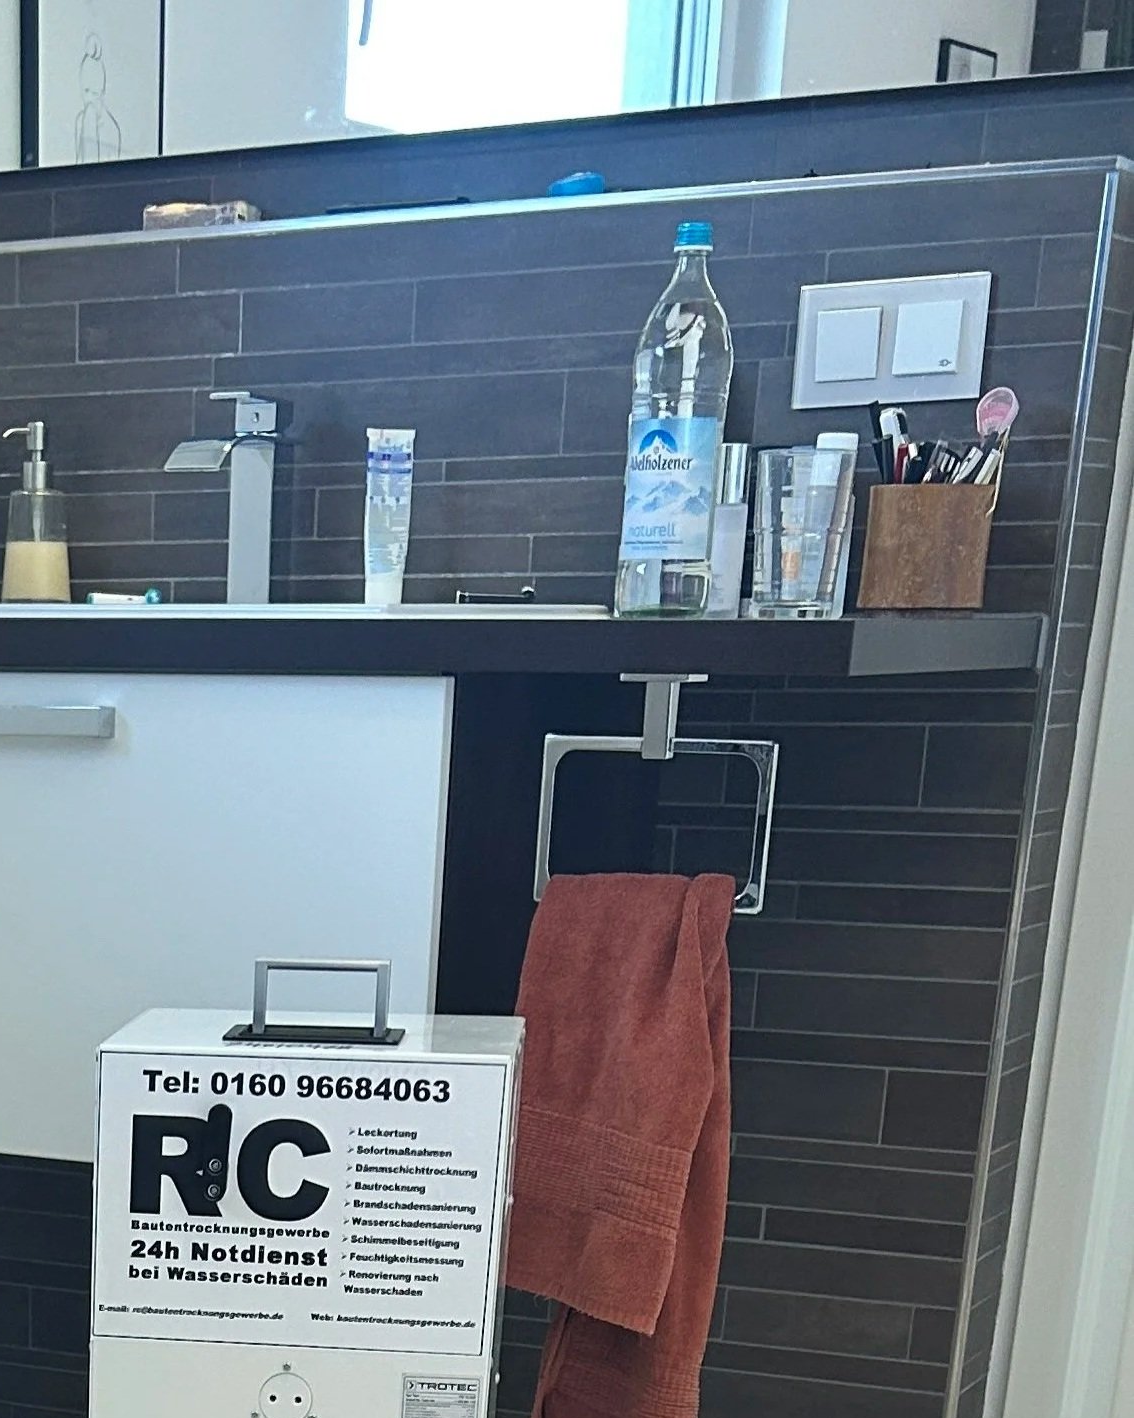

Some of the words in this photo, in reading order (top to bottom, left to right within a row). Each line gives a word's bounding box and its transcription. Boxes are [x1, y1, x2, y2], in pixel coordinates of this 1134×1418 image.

[143, 1070, 200, 1093] Tel:
[211, 1073, 286, 1097] 0160
[297, 1076, 451, 1103] 96684063
[358, 1127, 417, 1140] Leckortung
[357, 1146, 452, 1157] Sofortmaßnahmen
[356, 1164, 478, 1179] Dämmschichttrocknung
[354, 1182, 426, 1194] Bautrocknung
[354, 1200, 476, 1214] Brandschadensanierung
[131, 1220, 329, 1239] Bautentrocknungsgewerbe
[352, 1217, 482, 1233] Wasserschadensanierung
[351, 1235, 460, 1249] Schimmelbeseitigung
[131, 1240, 179, 1260] 24h
[192, 1243, 328, 1266] Notdienst
[350, 1252, 464, 1267] Feuchtigkeitsmessung
[129, 1265, 159, 1279] bei
[167, 1267, 328, 1287] Wasserschäden
[349, 1270, 411, 1283] Renovierung
[414, 1274, 439, 1282] nach
[344, 1285, 423, 1296] Wasserschaden
[311, 1313, 333, 1321] Web:
[417, 1382, 477, 1391] TROTEC
